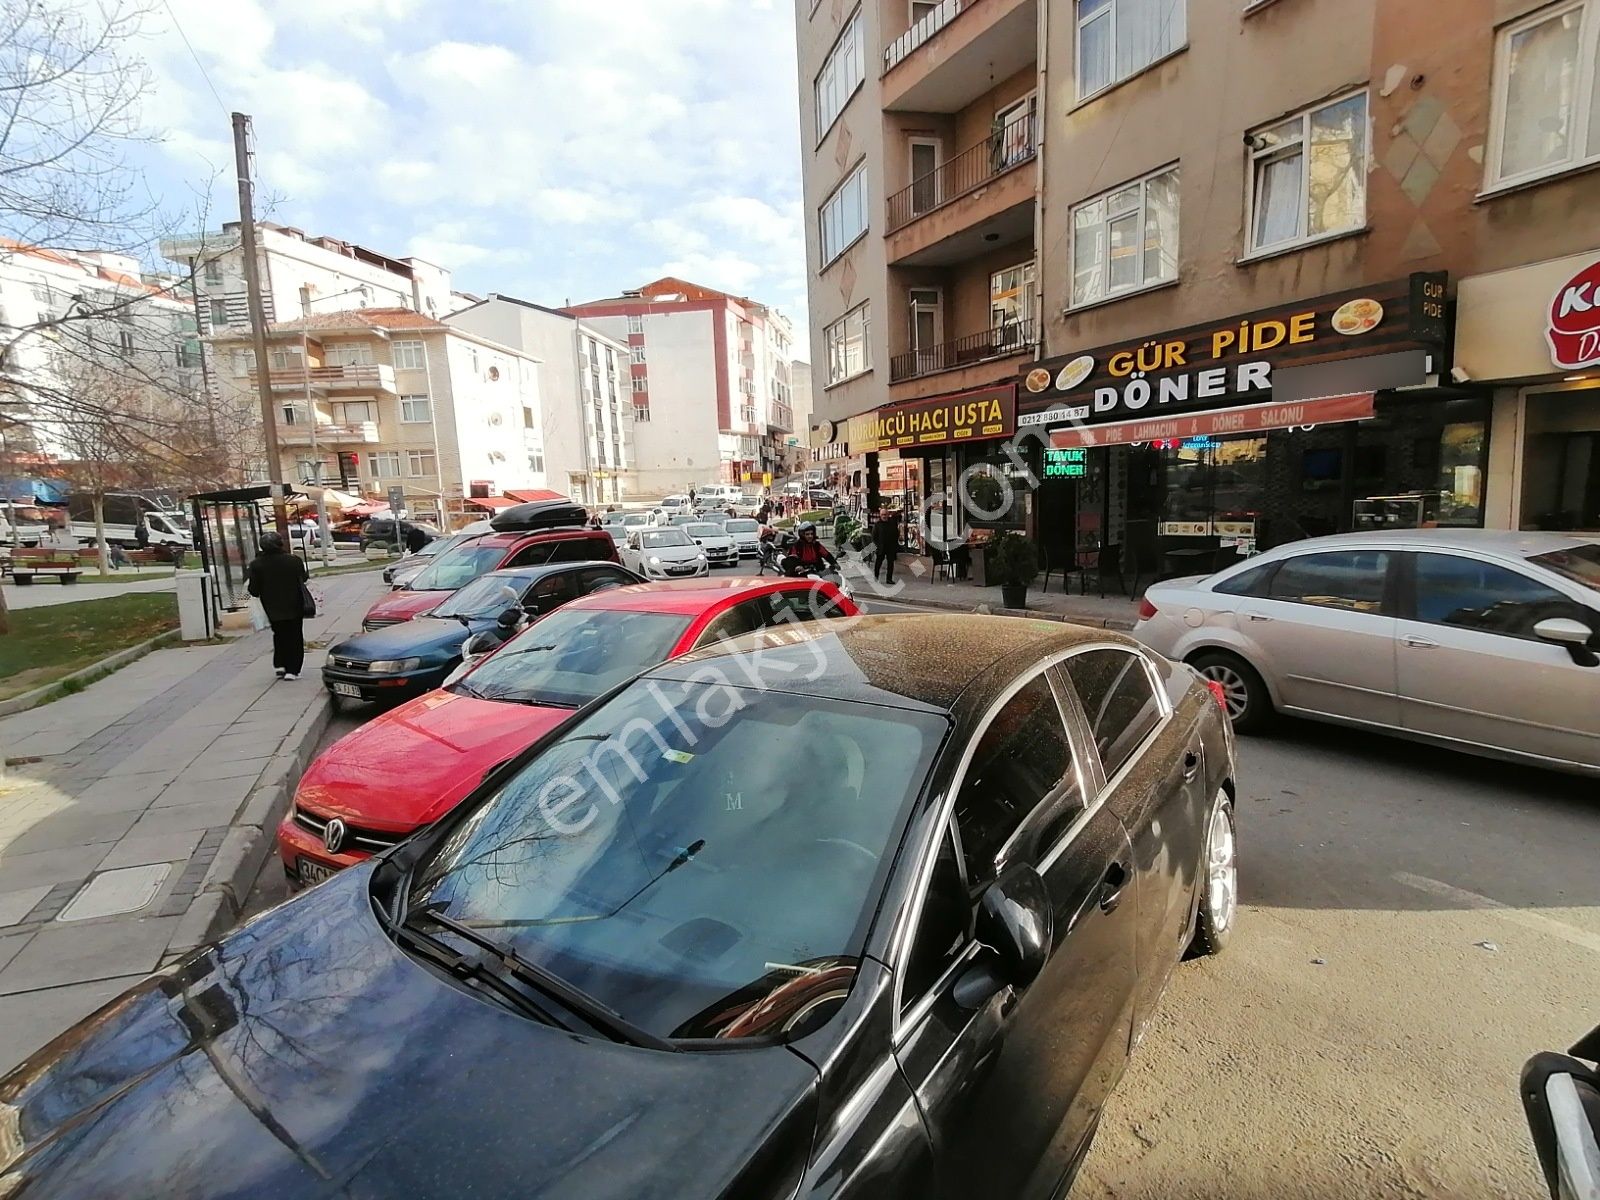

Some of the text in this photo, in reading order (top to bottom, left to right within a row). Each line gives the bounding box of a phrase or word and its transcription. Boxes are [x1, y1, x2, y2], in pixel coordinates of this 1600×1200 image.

[1108, 311, 1316, 378] GÜR PİDE
[1094, 360, 1273, 413] DÖNER
[909, 407, 949, 432] HACI
[954, 399, 1003, 427] USTA
[1022, 414, 1041, 424] 0212
[1133, 422, 1178, 440] LAHMACUN
[1211, 413, 1245, 432] DÖNER
[1260, 405, 1304, 427] SALONU
[1046, 450, 1085, 462] TAVUK
[1046, 462, 1085, 476] DÖNER
